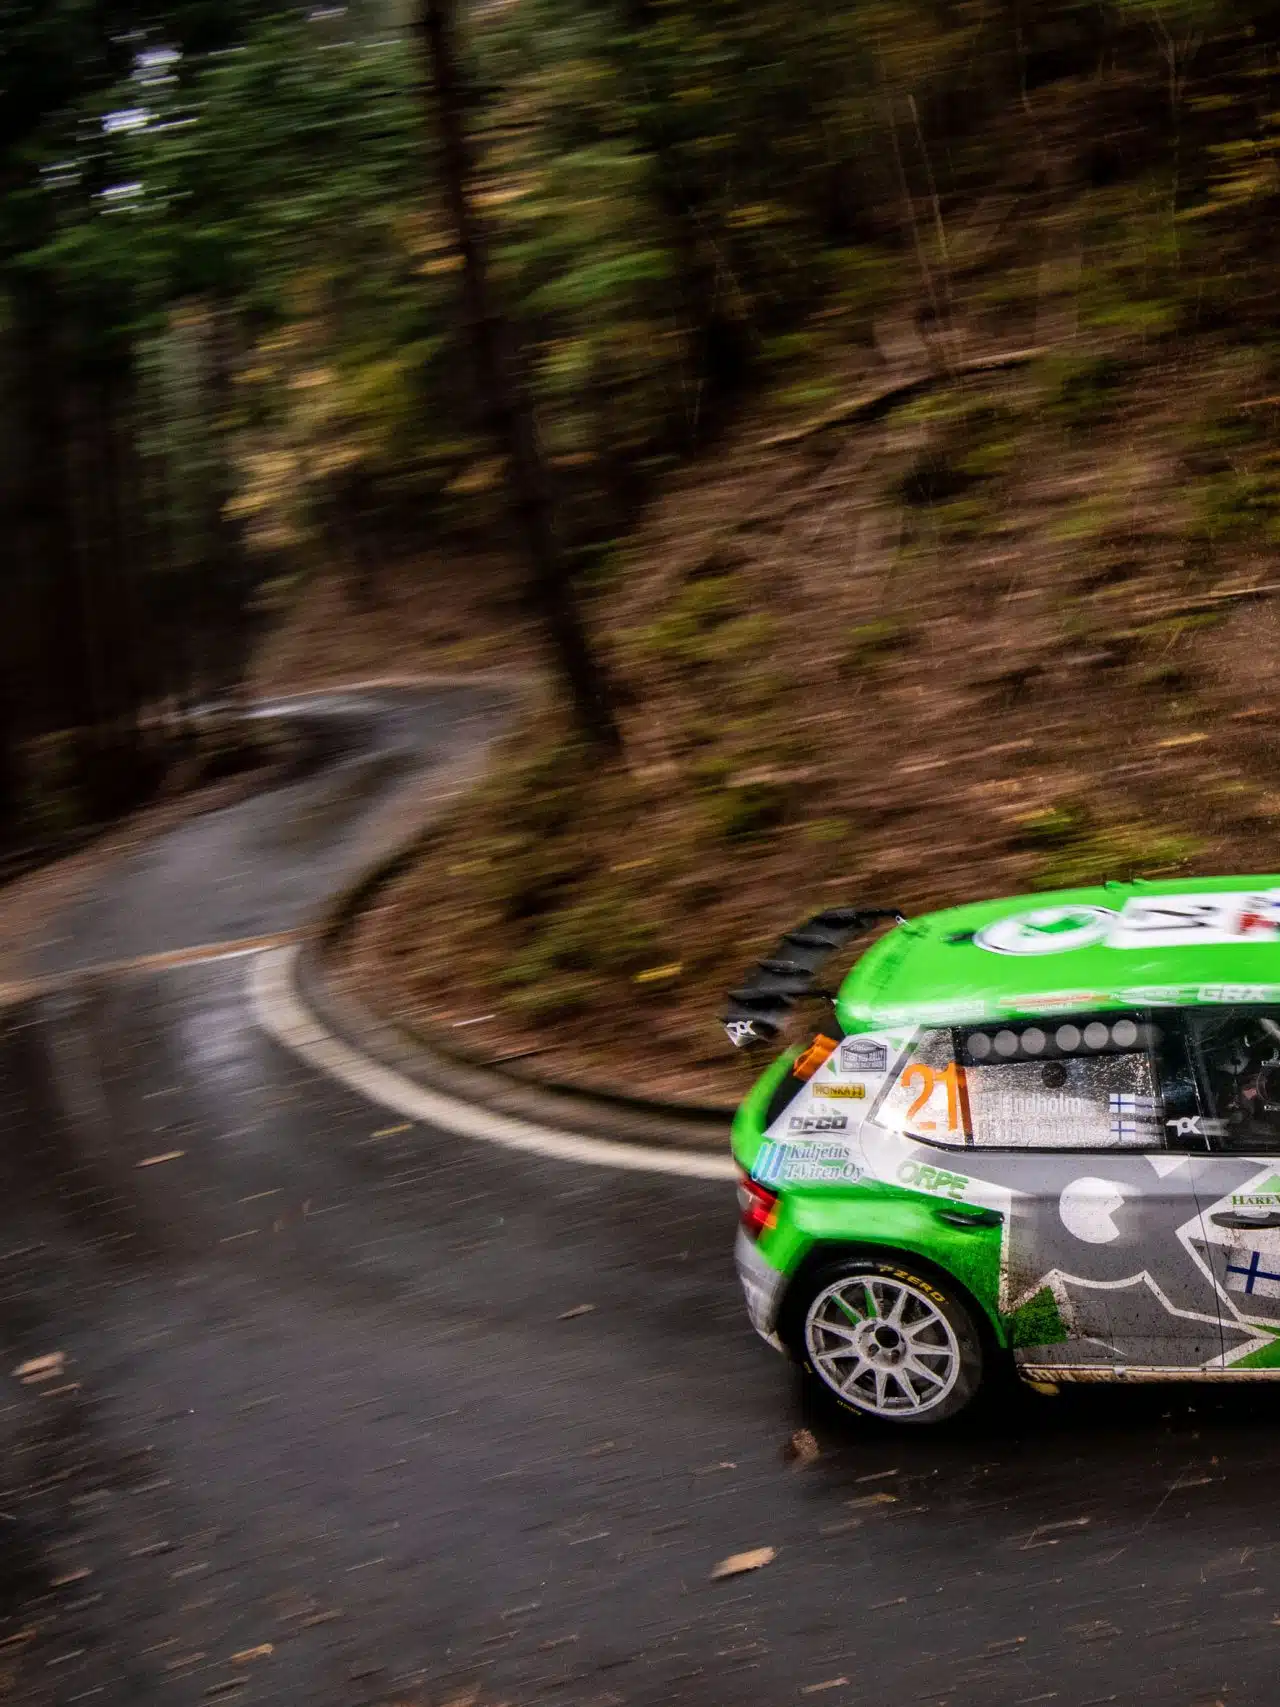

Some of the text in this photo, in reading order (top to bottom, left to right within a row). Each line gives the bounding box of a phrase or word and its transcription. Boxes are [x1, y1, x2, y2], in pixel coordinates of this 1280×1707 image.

[901, 1061, 970, 1132] 21
[789, 1143, 851, 1162] Kuljetus
[842, 1162, 864, 1181] Oy
[893, 1270, 947, 1303] ZERO
